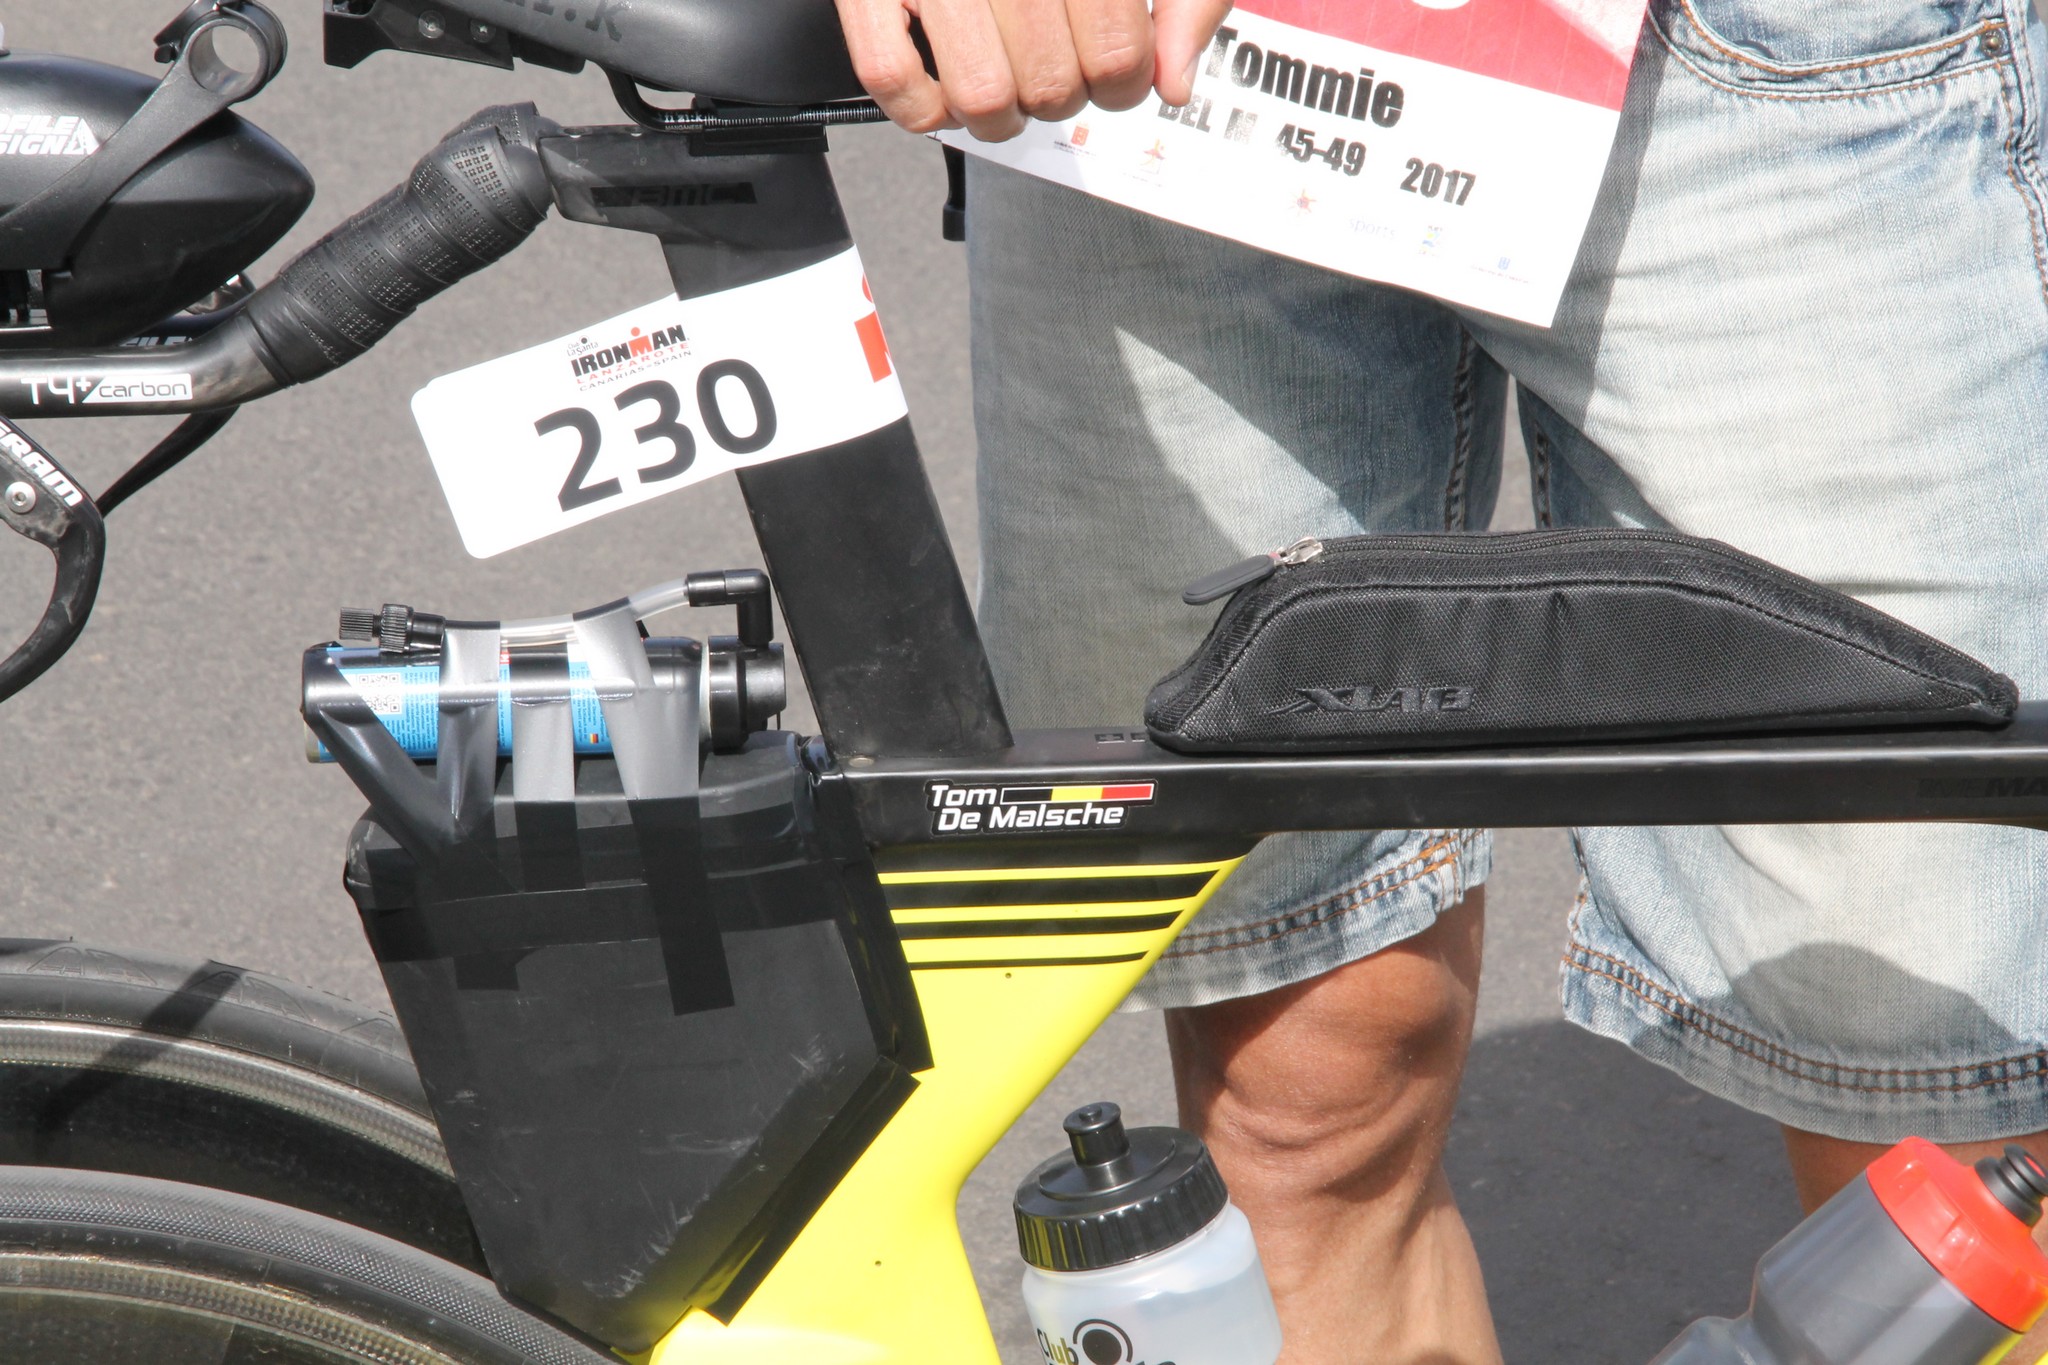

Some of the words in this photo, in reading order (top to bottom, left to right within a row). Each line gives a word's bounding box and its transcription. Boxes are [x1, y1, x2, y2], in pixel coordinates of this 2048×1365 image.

[1205, 26, 1404, 128] Tommie
[1276, 123, 1367, 177] 45-49
[1400, 157, 1477, 206] 2017
[571, 324, 687, 377] IRONMAN
[577, 342, 689, 384] LANZAROTE
[99, 381, 187, 398] carbon
[534, 359, 777, 513] 230
[931, 785, 997, 807] Tom
[938, 808, 981, 831] De
[989, 802, 1125, 829] Malsche
[1037, 1328, 1079, 1365] Club
